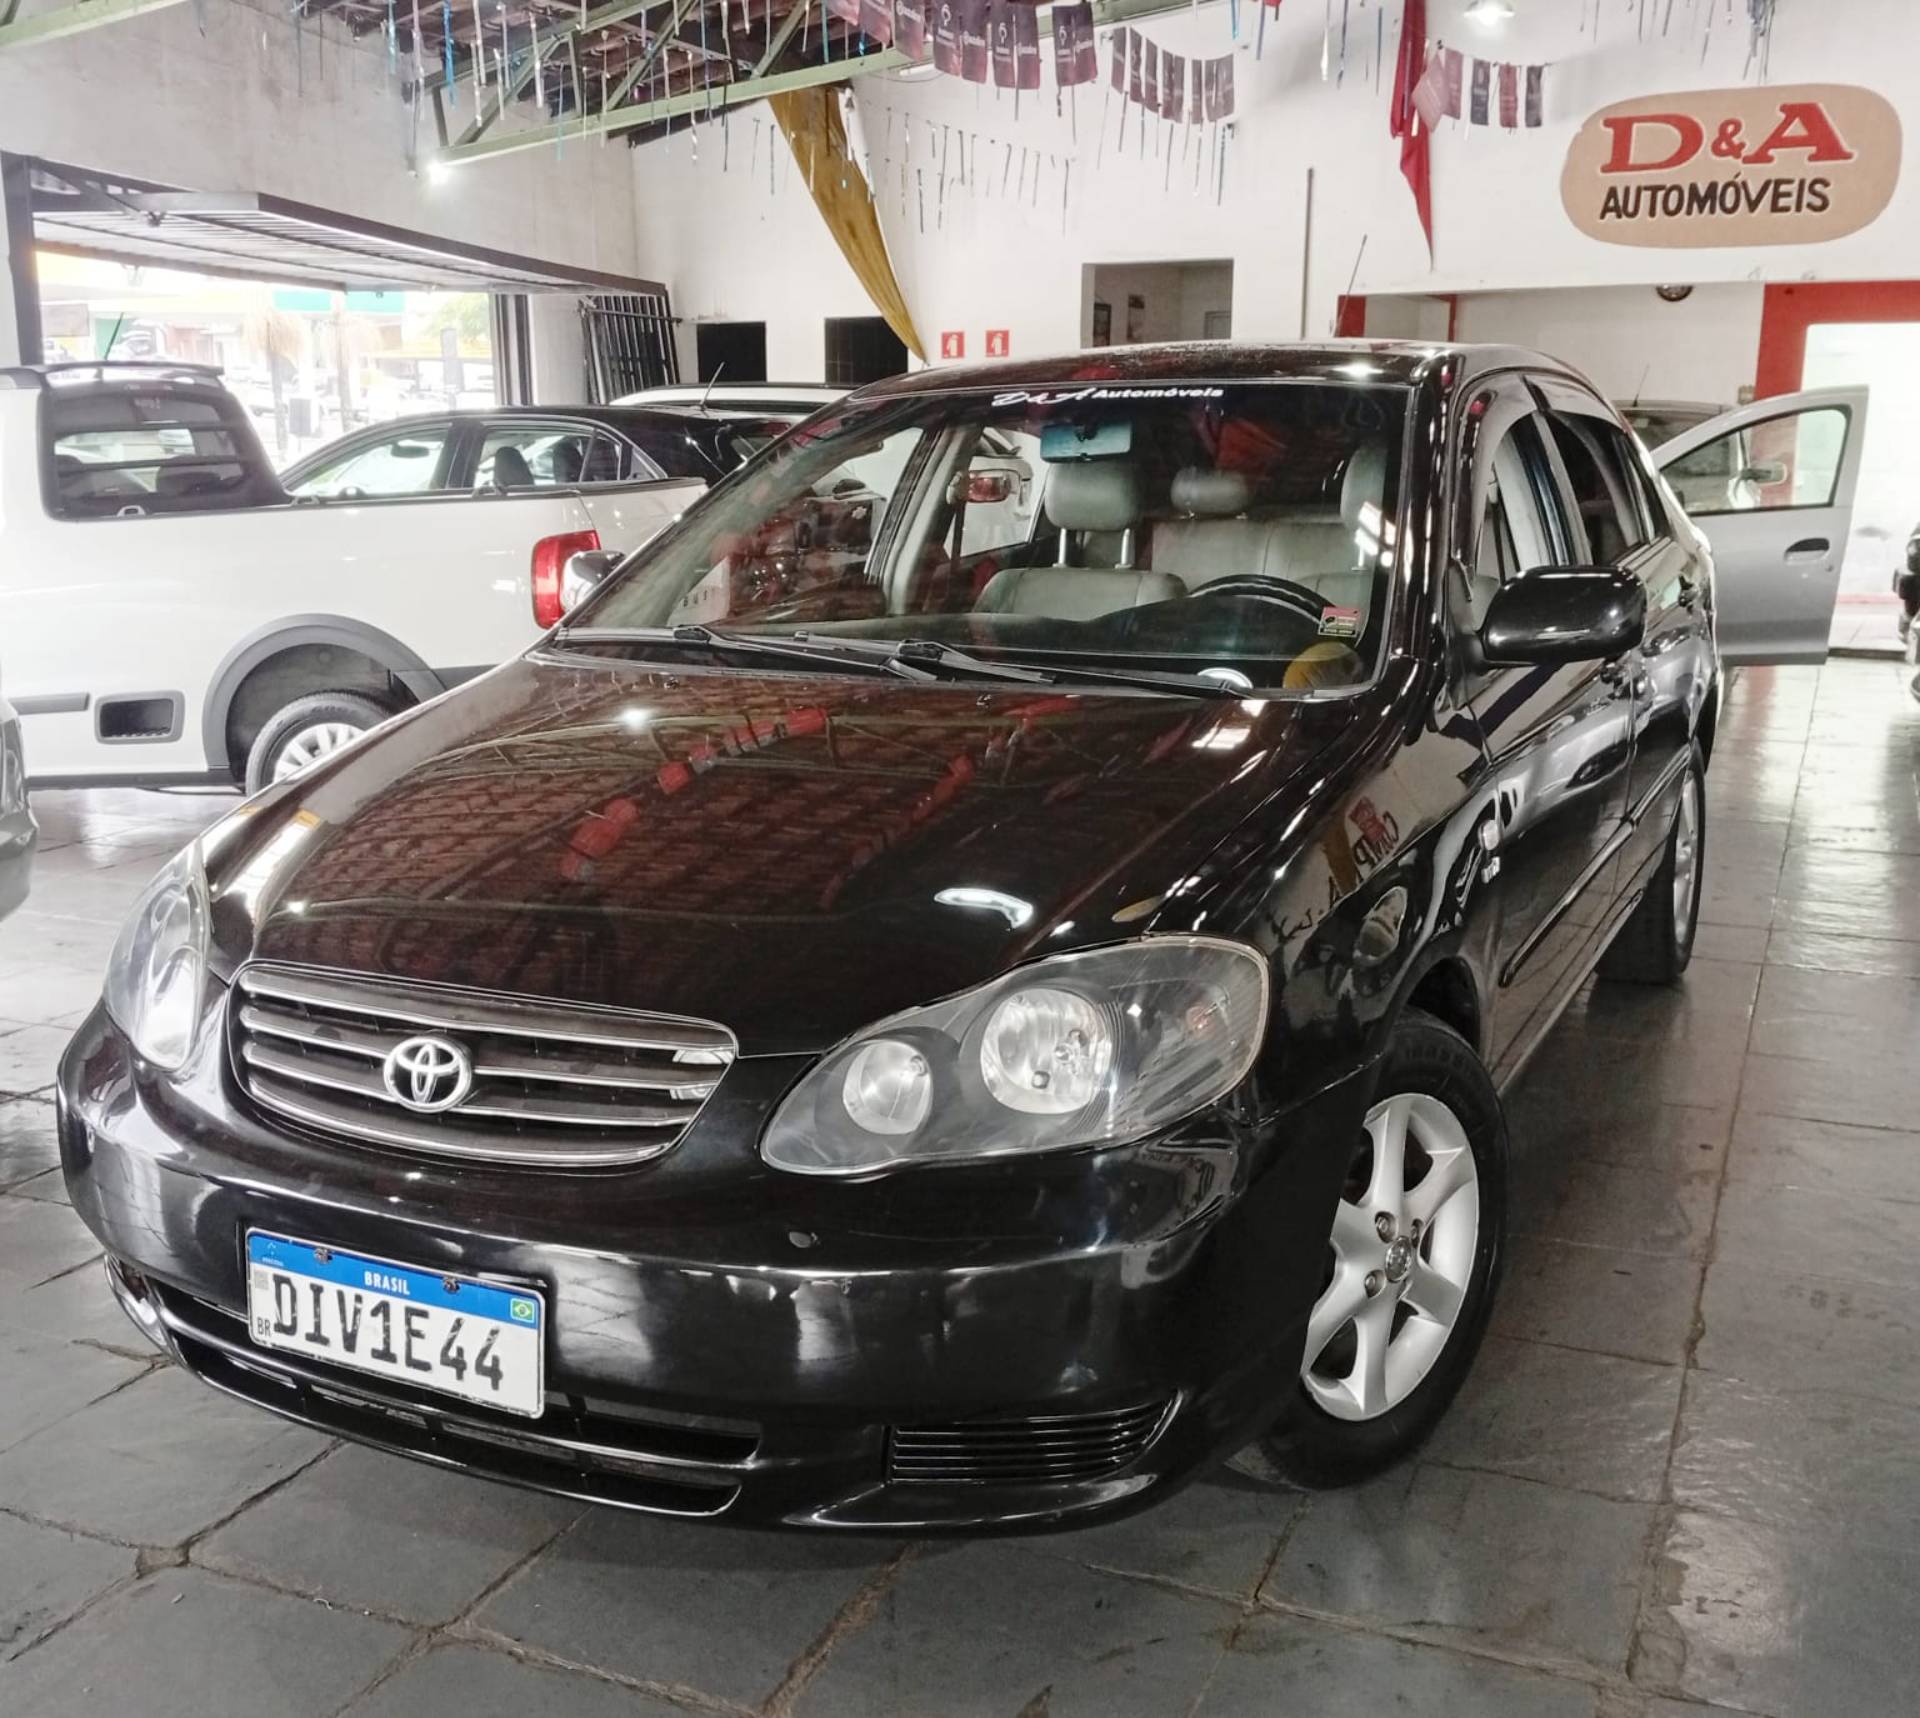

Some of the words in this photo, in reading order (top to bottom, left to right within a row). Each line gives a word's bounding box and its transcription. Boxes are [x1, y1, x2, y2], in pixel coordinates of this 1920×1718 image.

[1600, 102, 1854, 173] D&A
[1600, 172, 1831, 220] AUTOMÓVEIS
[1091, 387, 1225, 399] Automóveis
[364, 1271, 411, 1296] BRASIL
[257, 1317, 271, 1337] BR
[273, 1273, 503, 1391] DIV1E44
